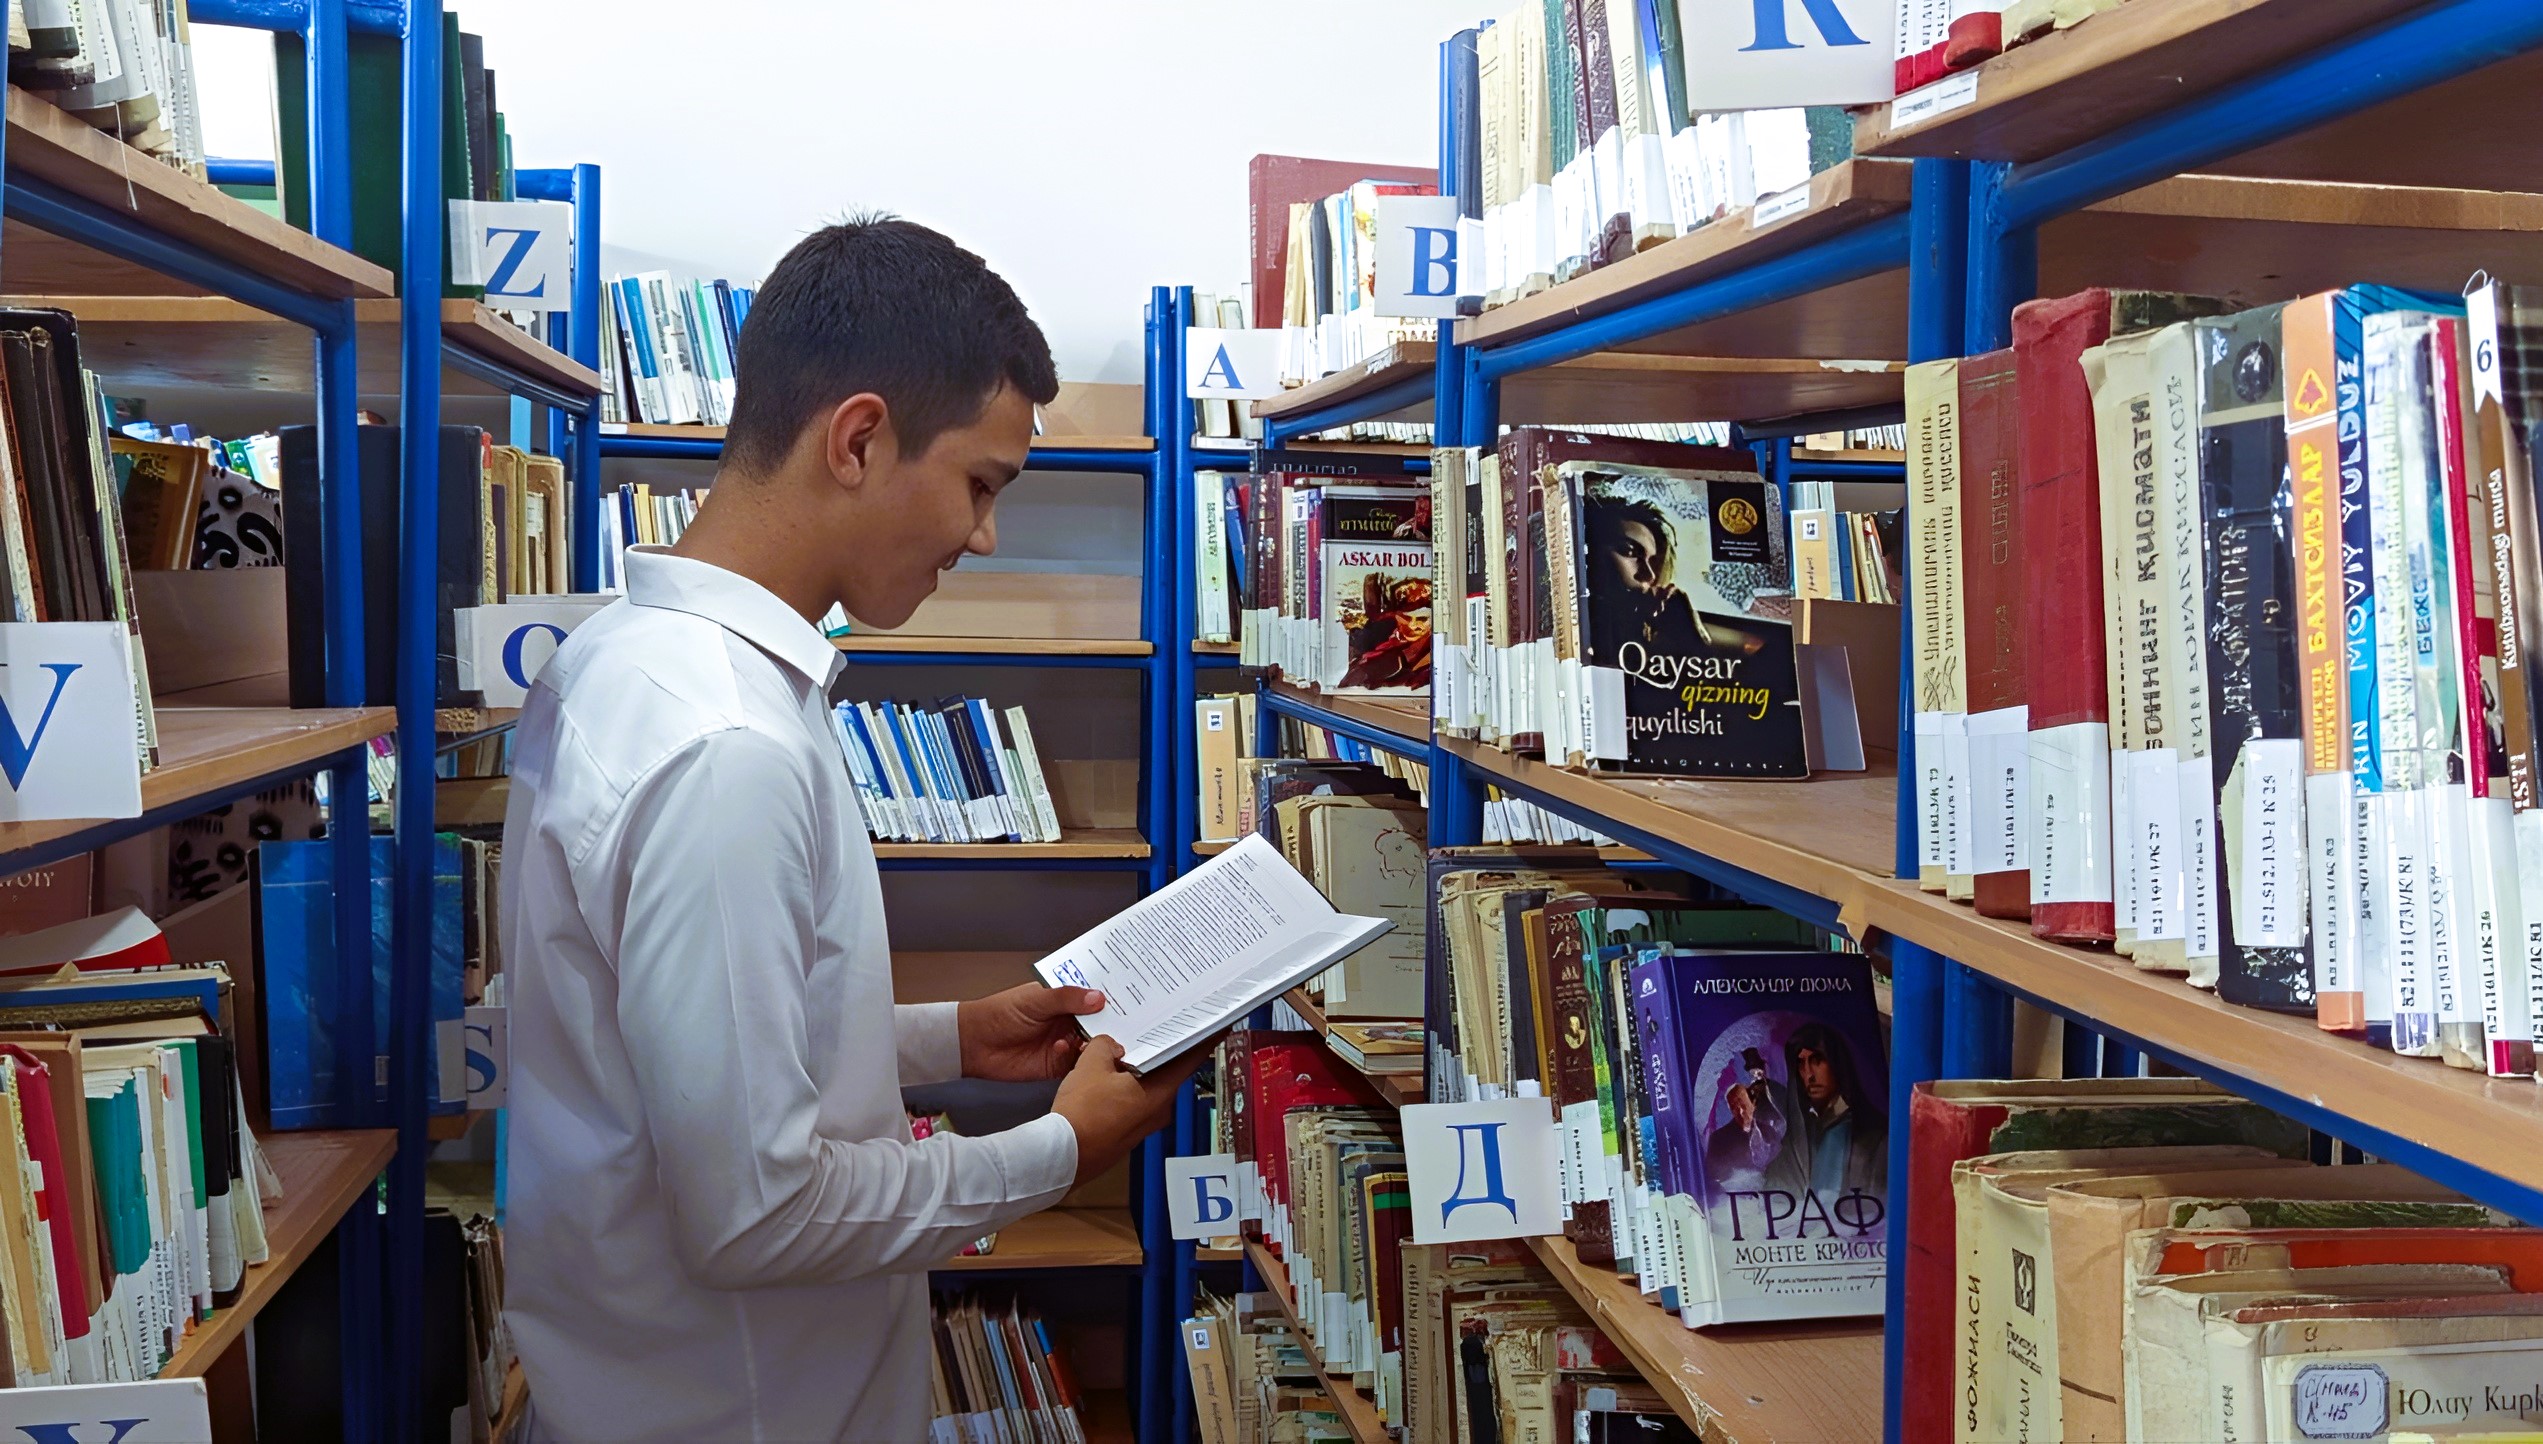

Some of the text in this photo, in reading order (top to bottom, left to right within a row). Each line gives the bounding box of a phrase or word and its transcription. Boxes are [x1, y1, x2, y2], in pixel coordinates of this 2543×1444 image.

[486, 228, 546, 298] Z
[2476, 339, 2492, 373] 6
[2337, 355, 2368, 671] MOVIY YULDUZ
[1339, 551, 1394, 567] ASKAR
[2300, 443, 2328, 654] БАХТСИЗЛАР
[1618, 641, 1742, 690] Qaysar
[1625, 707, 1724, 741] quyilishi
[1681, 680, 1770, 721] qizning
[1189, 1174, 1234, 1225] Б
[1441, 1122, 1518, 1229] Д
[1725, 1187, 1885, 1241] ГРАФ
[1735, 1244, 1807, 1265] МОНТЕ
